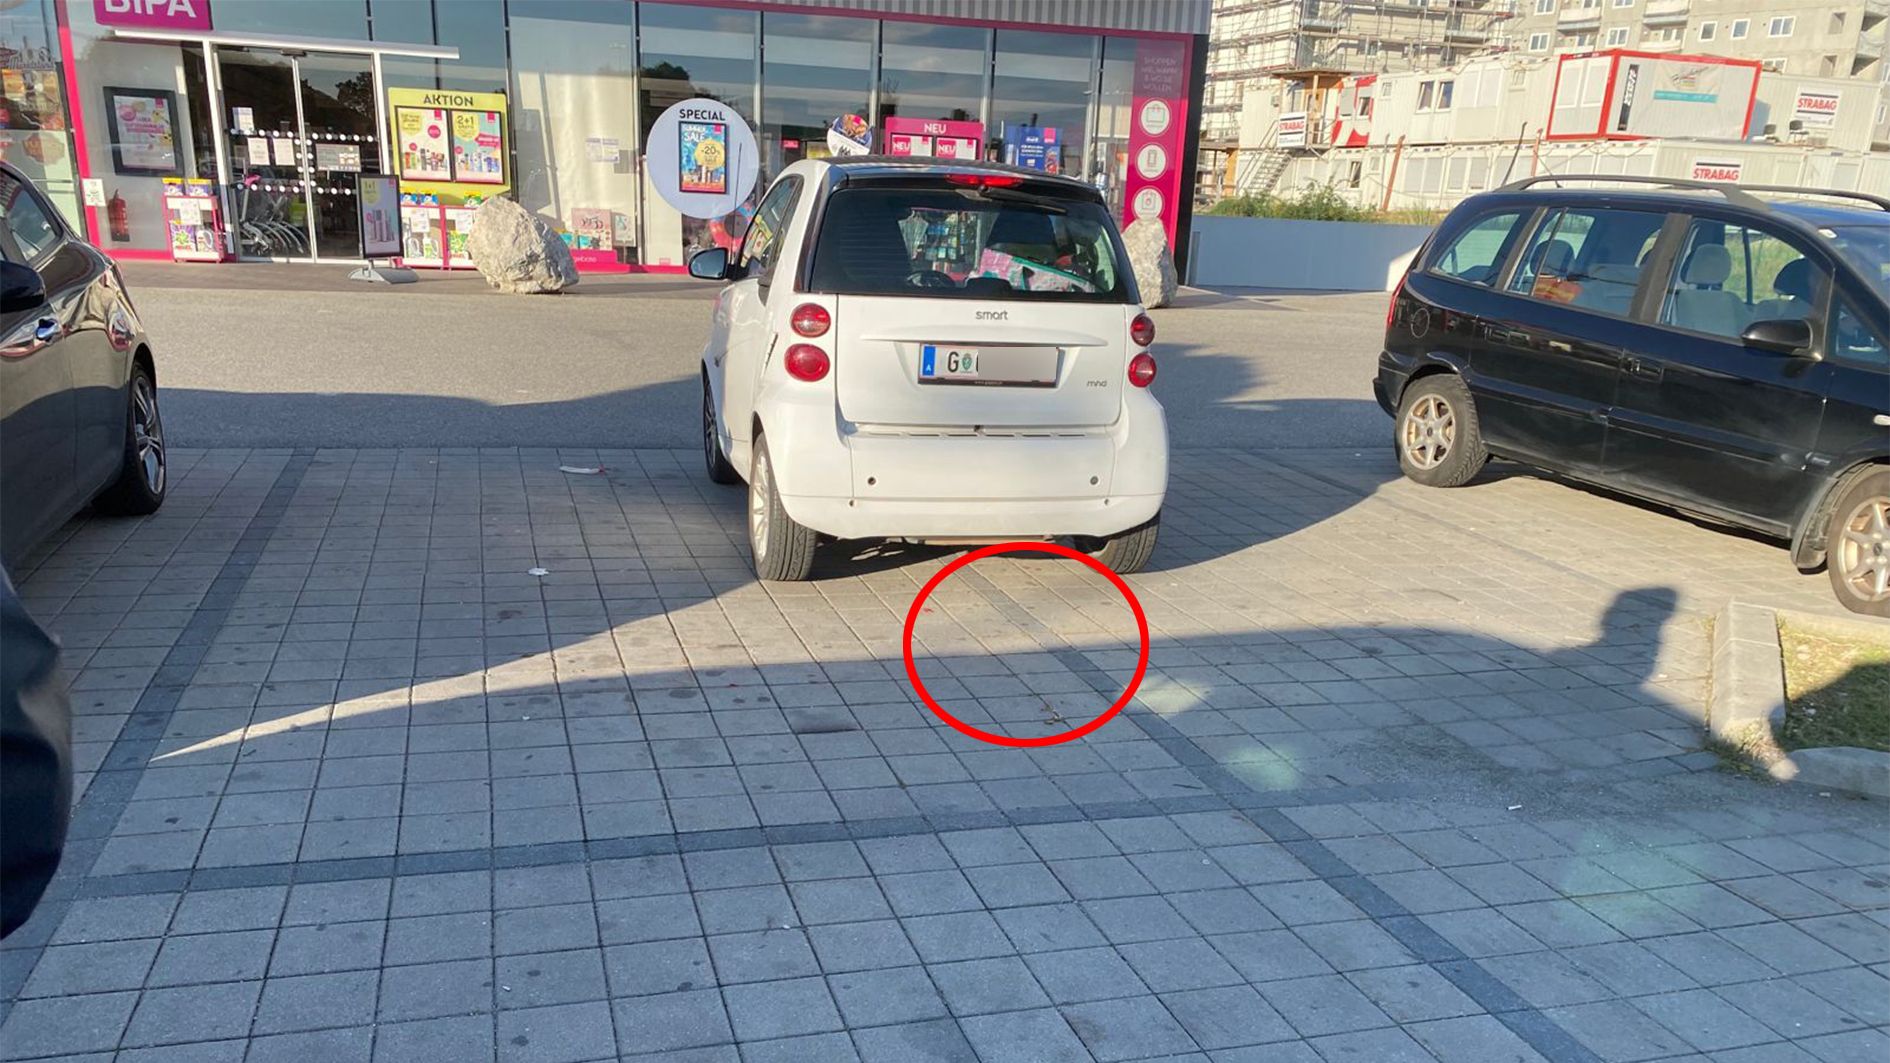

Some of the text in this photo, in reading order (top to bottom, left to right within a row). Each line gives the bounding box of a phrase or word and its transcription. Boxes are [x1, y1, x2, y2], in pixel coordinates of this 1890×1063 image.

[423, 94, 474, 106] AKTION
[1797, 98, 1838, 110] STRABAG
[456, 115, 474, 124] 2+1
[679, 109, 726, 121] SPECIAL
[923, 123, 947, 134] NEU
[683, 132, 705, 142] SALE
[893, 141, 910, 151] NEU
[938, 144, 955, 154] NEU
[1692, 168, 1739, 181] STRABAG
[975, 310, 1008, 320] smart
[947, 351, 959, 373] G
[1086, 380, 1107, 388] mhd
